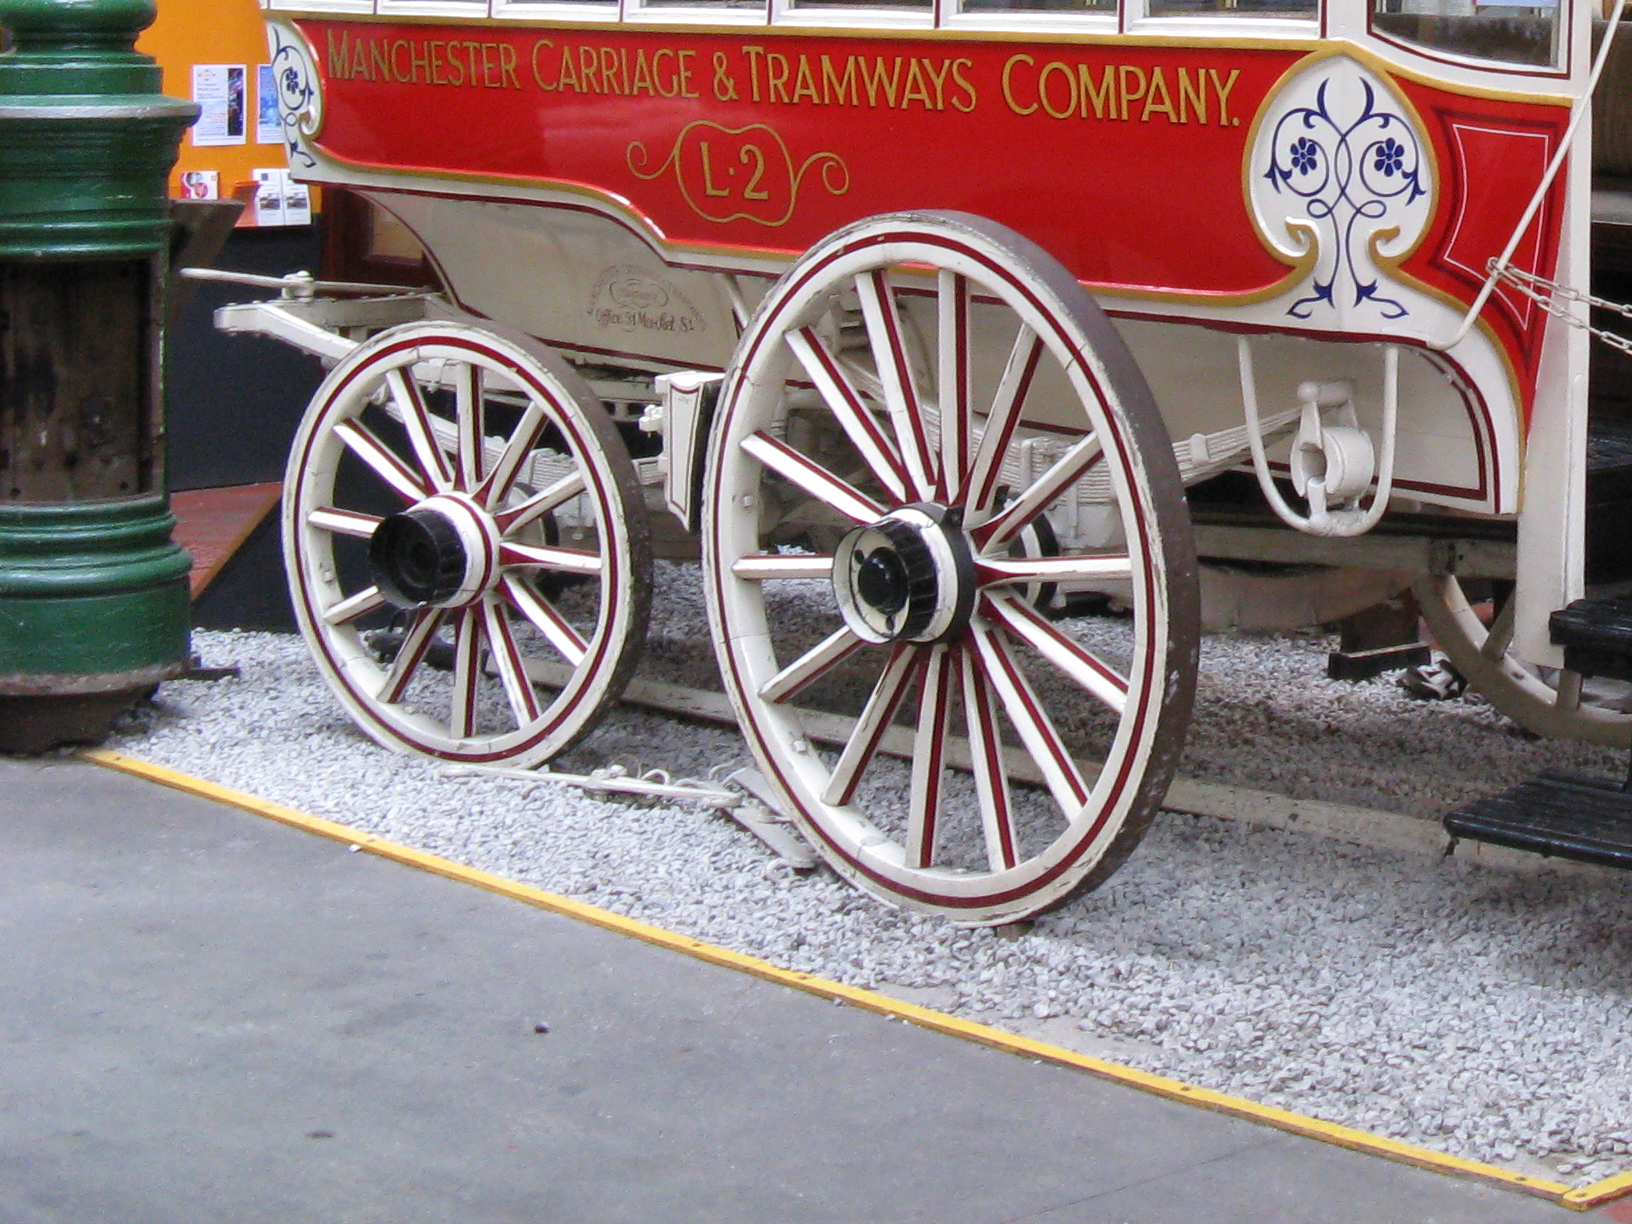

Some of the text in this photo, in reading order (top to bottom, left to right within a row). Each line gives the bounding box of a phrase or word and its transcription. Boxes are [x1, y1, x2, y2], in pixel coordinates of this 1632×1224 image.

[326, 29, 1241, 127] MANCHESTER CARRIAGE & TRAMWAYS COMPANY.
